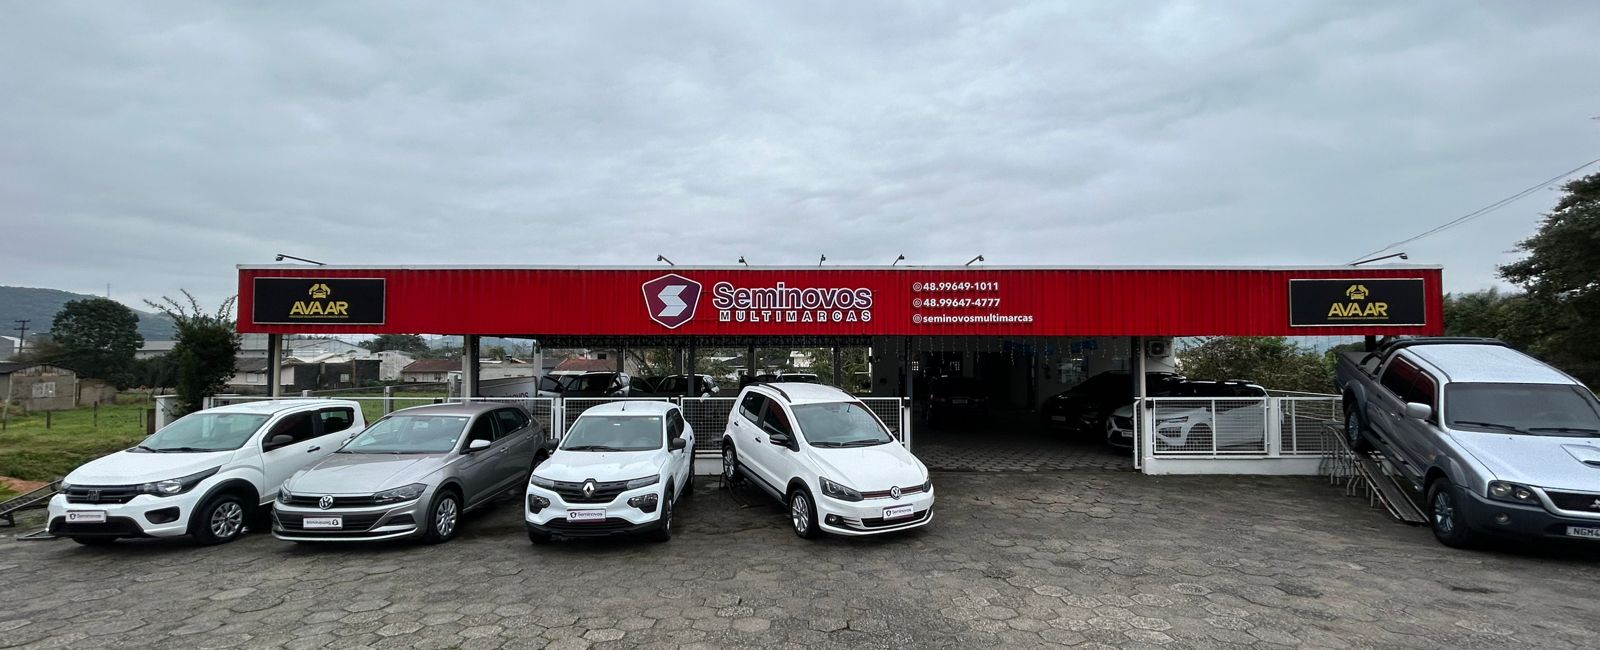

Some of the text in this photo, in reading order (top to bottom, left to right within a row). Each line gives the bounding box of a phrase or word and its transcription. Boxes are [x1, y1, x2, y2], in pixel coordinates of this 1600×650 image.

[922, 282, 999, 292] 48.99649-1011
[713, 281, 873, 310] Seminovos
[923, 298, 1000, 308] 48.99647-4777
[719, 310, 872, 323] MULTIMARCAS
[922, 313, 1033, 324] seminovosmultimarcas
